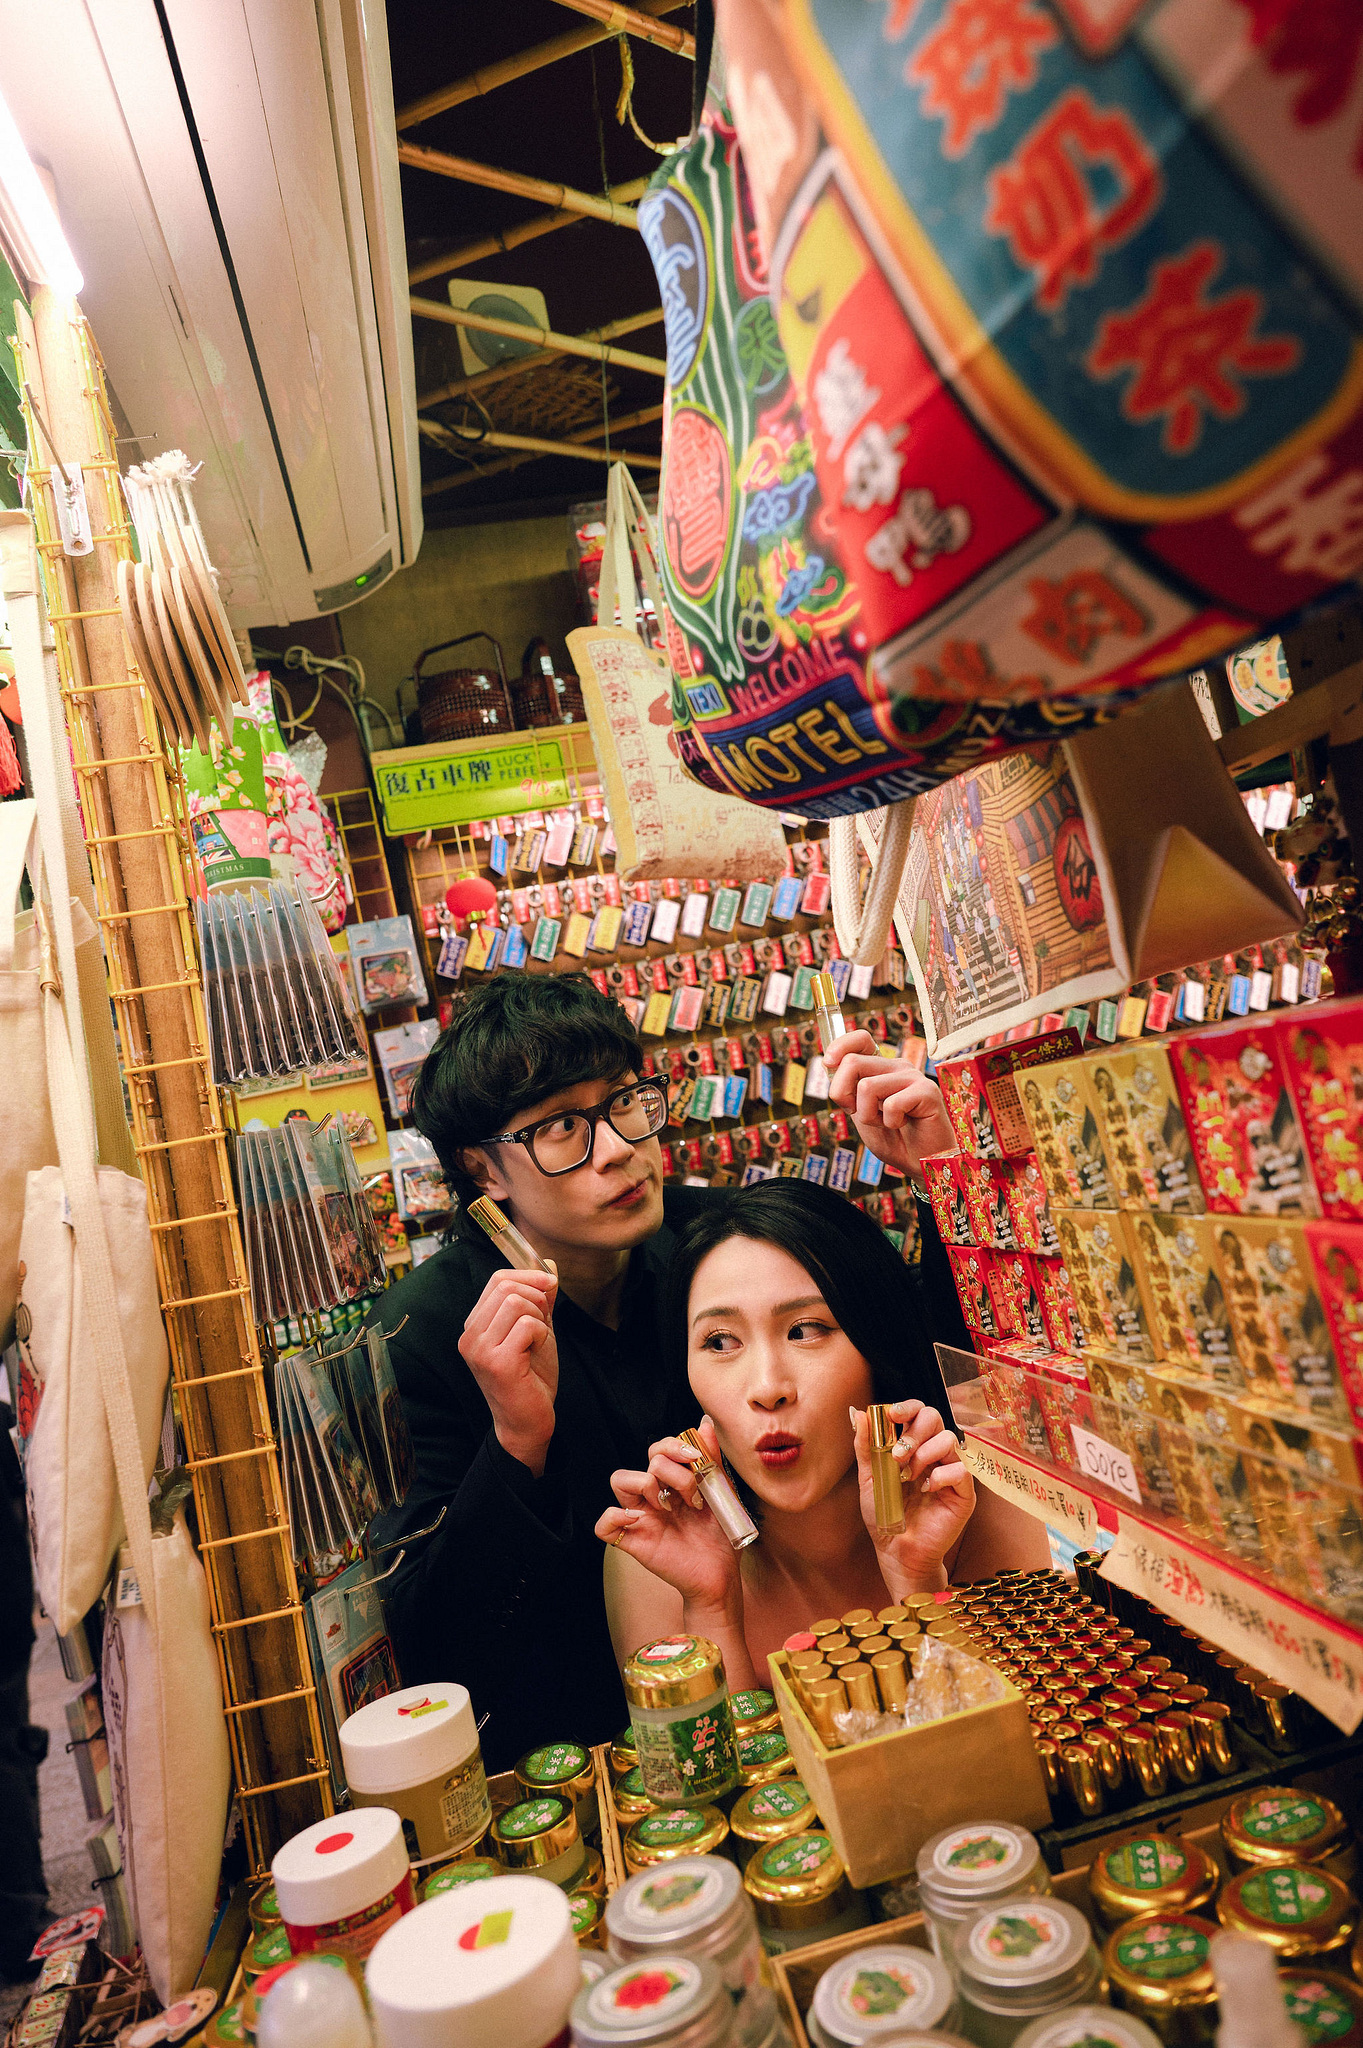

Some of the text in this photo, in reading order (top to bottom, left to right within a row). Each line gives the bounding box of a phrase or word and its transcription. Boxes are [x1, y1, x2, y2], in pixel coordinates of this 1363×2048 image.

[884, 0, 1298, 454] 珠奶茶
[728, 624, 846, 716] WELCOME
[385, 759, 493, 797] 復古車牌
[711, 701, 889, 792] MOTEL
[1021, 1035, 1075, 1058] 一條根
[1085, 1441, 1133, 1492] Sore
